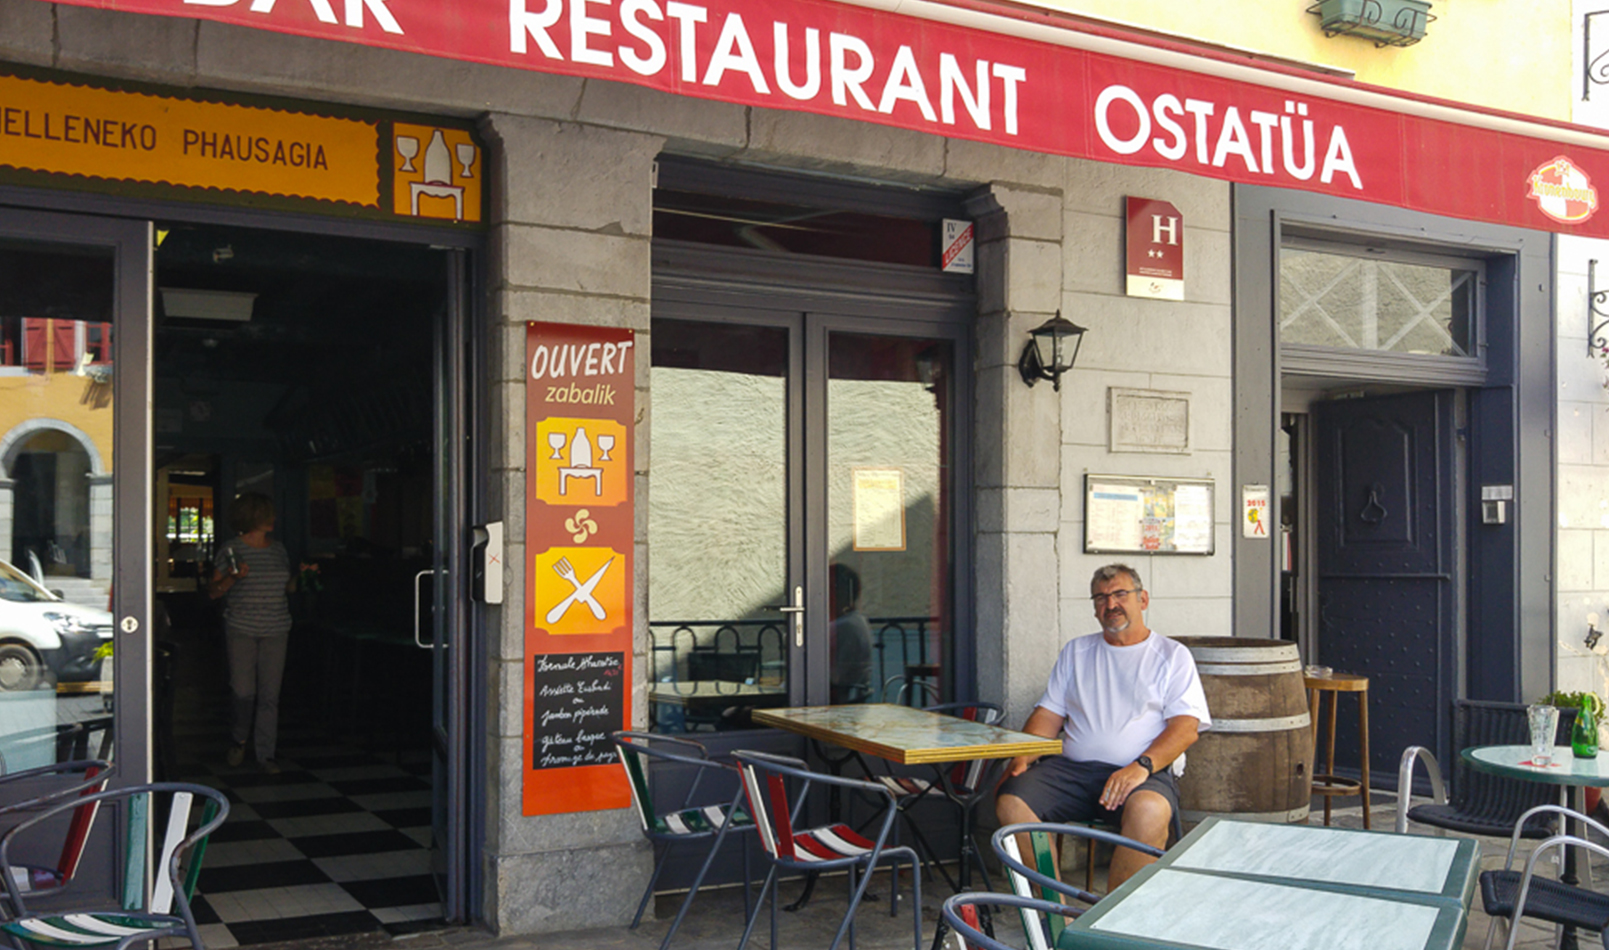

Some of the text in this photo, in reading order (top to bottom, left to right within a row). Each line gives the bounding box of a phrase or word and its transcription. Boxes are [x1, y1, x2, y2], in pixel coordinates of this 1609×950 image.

[508, 0, 1027, 136] RESTAURANT
[0, 106, 328, 171] ELLENEKO PHAUSAGIA
[1094, 84, 1363, 190] OSTATÜA
[1151, 214, 1178, 246] H
[531, 341, 633, 379] OUVERT
[545, 382, 616, 405] zabalik
